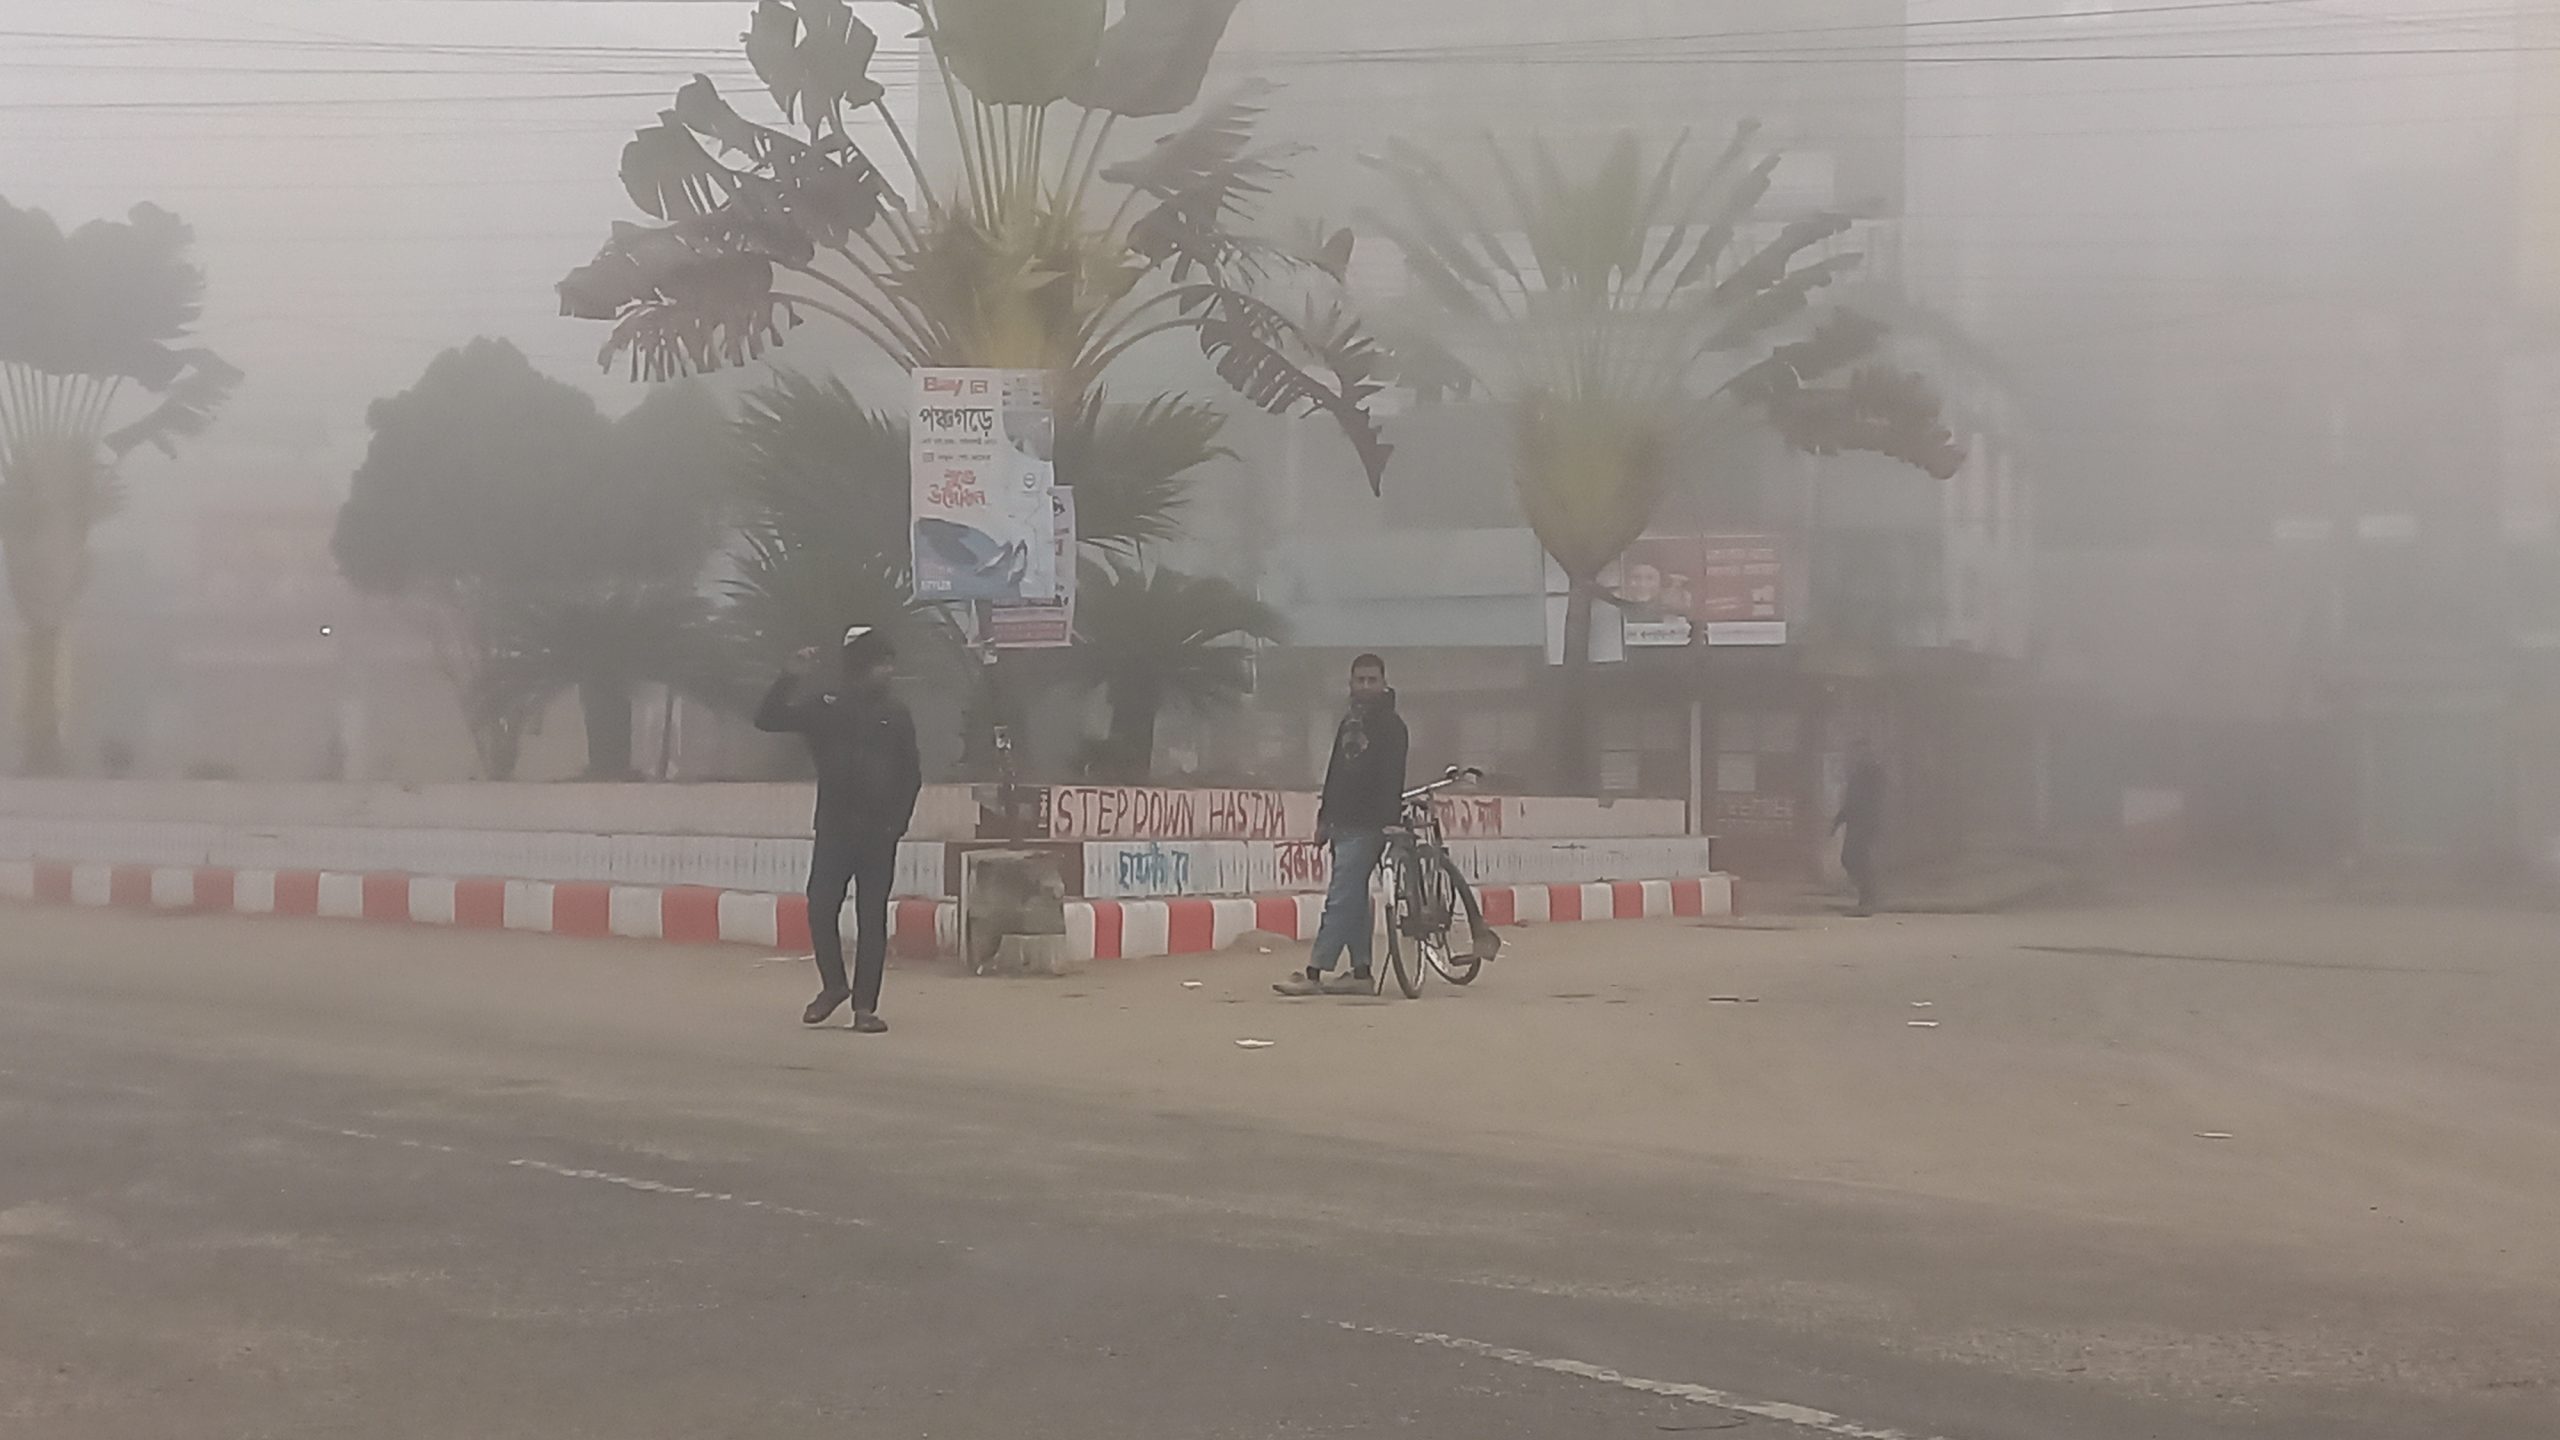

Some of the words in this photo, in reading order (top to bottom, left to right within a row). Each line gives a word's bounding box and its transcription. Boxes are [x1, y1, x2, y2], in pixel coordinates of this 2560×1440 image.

[919, 405, 994, 437] পঞ্চগড়ে
[1055, 788, 1129, 836] STEP
[1132, 789, 1194, 836] DOWN
[1209, 790, 1286, 838] HASINA
